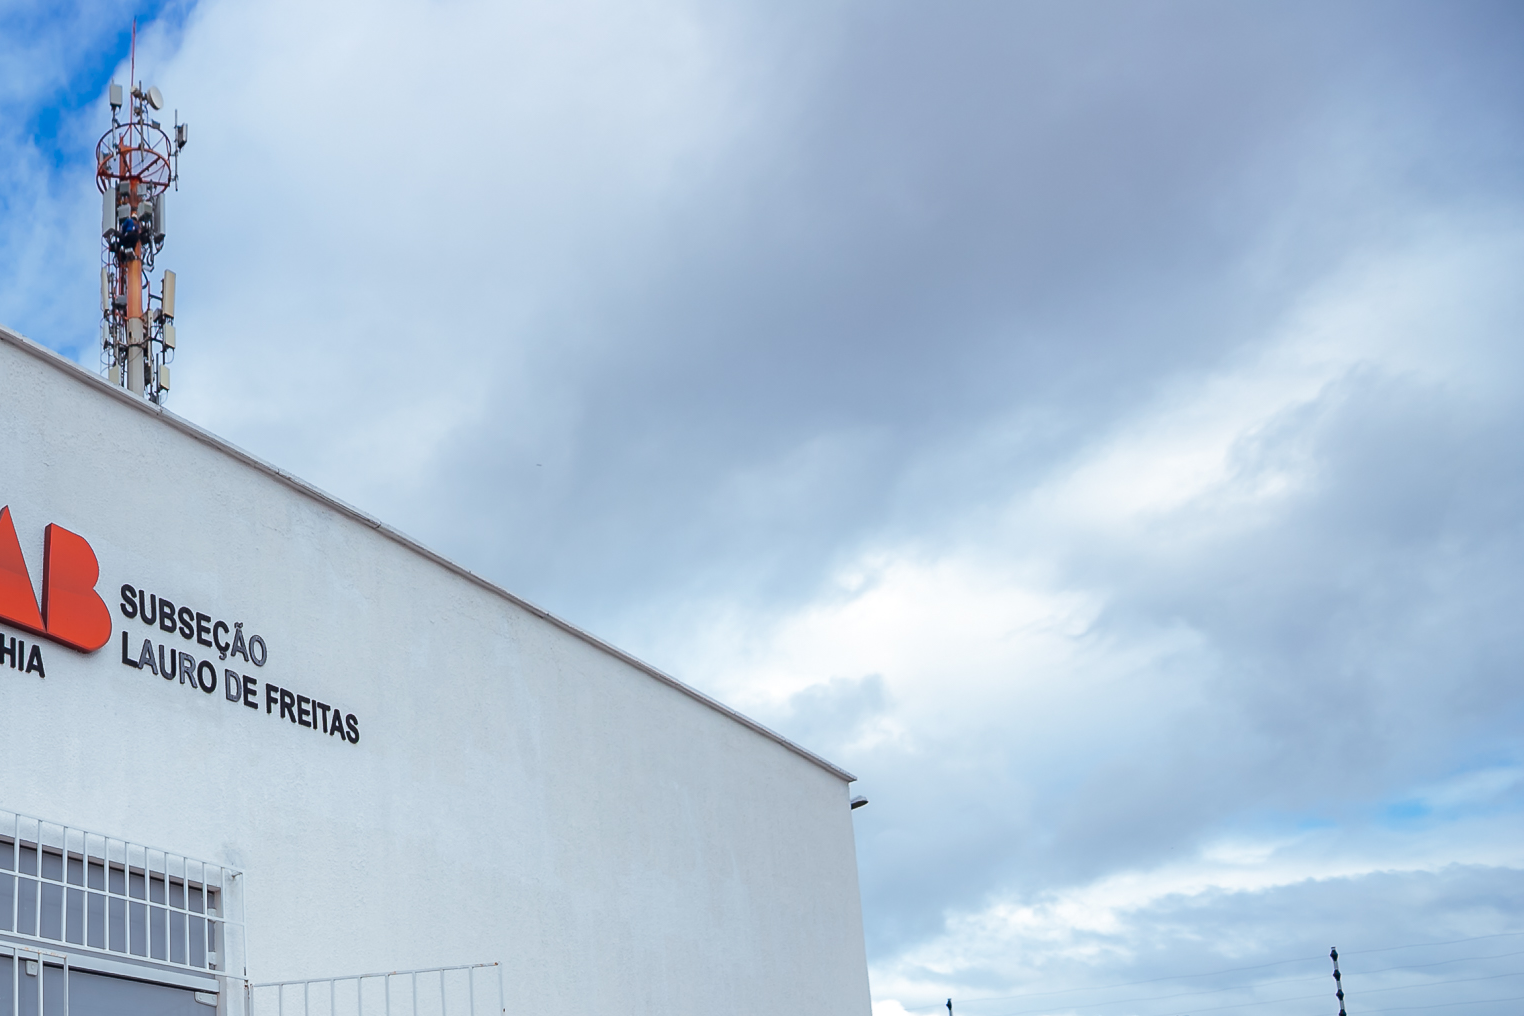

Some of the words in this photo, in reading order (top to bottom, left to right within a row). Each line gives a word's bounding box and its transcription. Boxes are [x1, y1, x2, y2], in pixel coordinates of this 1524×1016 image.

[120, 583, 268, 667] SUBSEÇÃO
[122, 631, 217, 693] LAURO
[225, 668, 258, 709] DE
[265, 683, 360, 744] FREITAS
